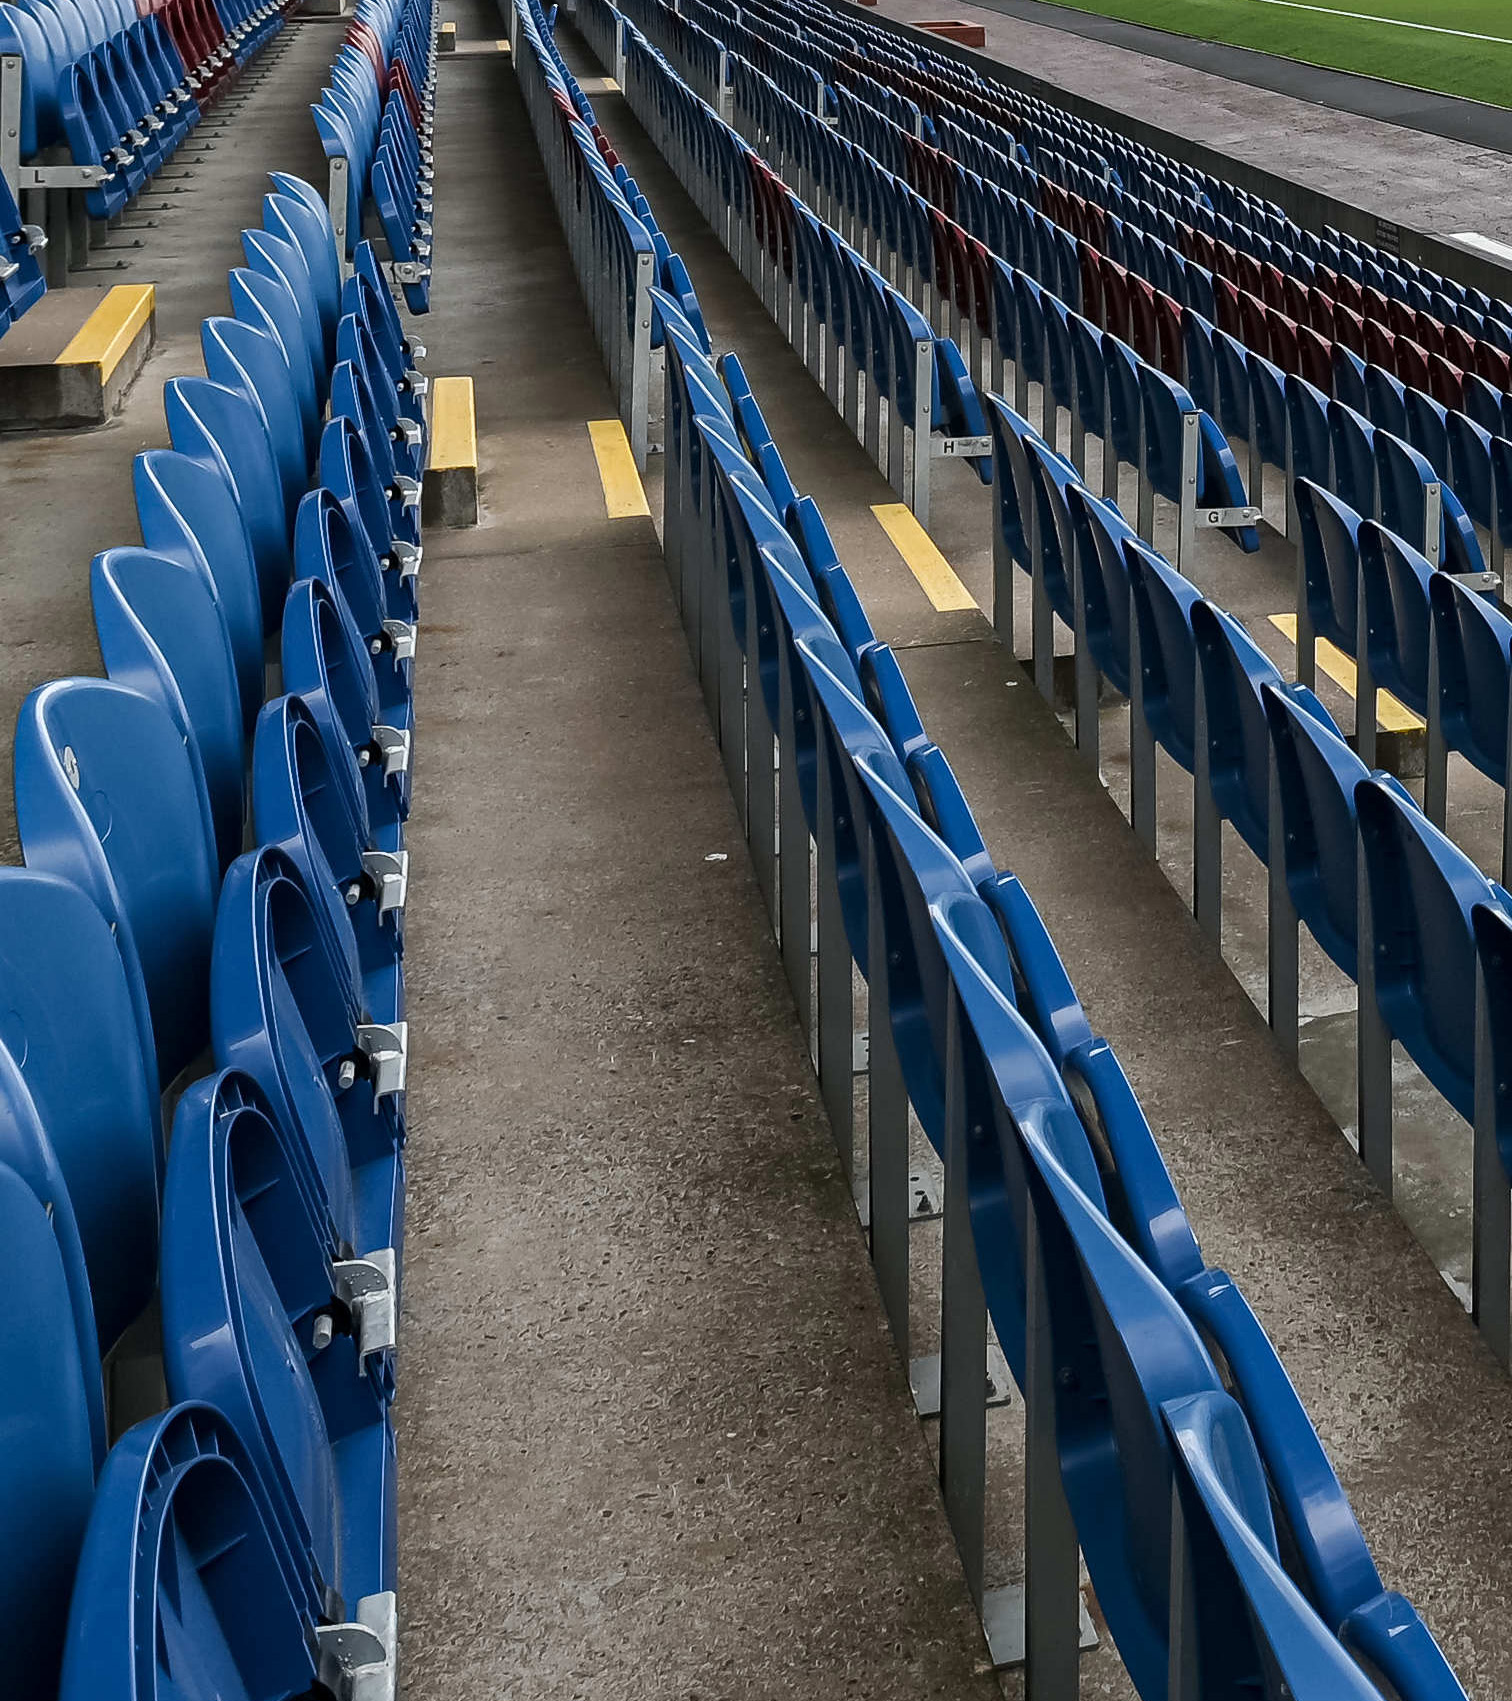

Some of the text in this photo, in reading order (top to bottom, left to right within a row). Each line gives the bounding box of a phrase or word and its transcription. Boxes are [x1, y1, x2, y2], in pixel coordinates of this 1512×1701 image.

[34, 169, 45, 184] L
[943, 441, 954, 454] H
[1208, 511, 1219, 524] G
